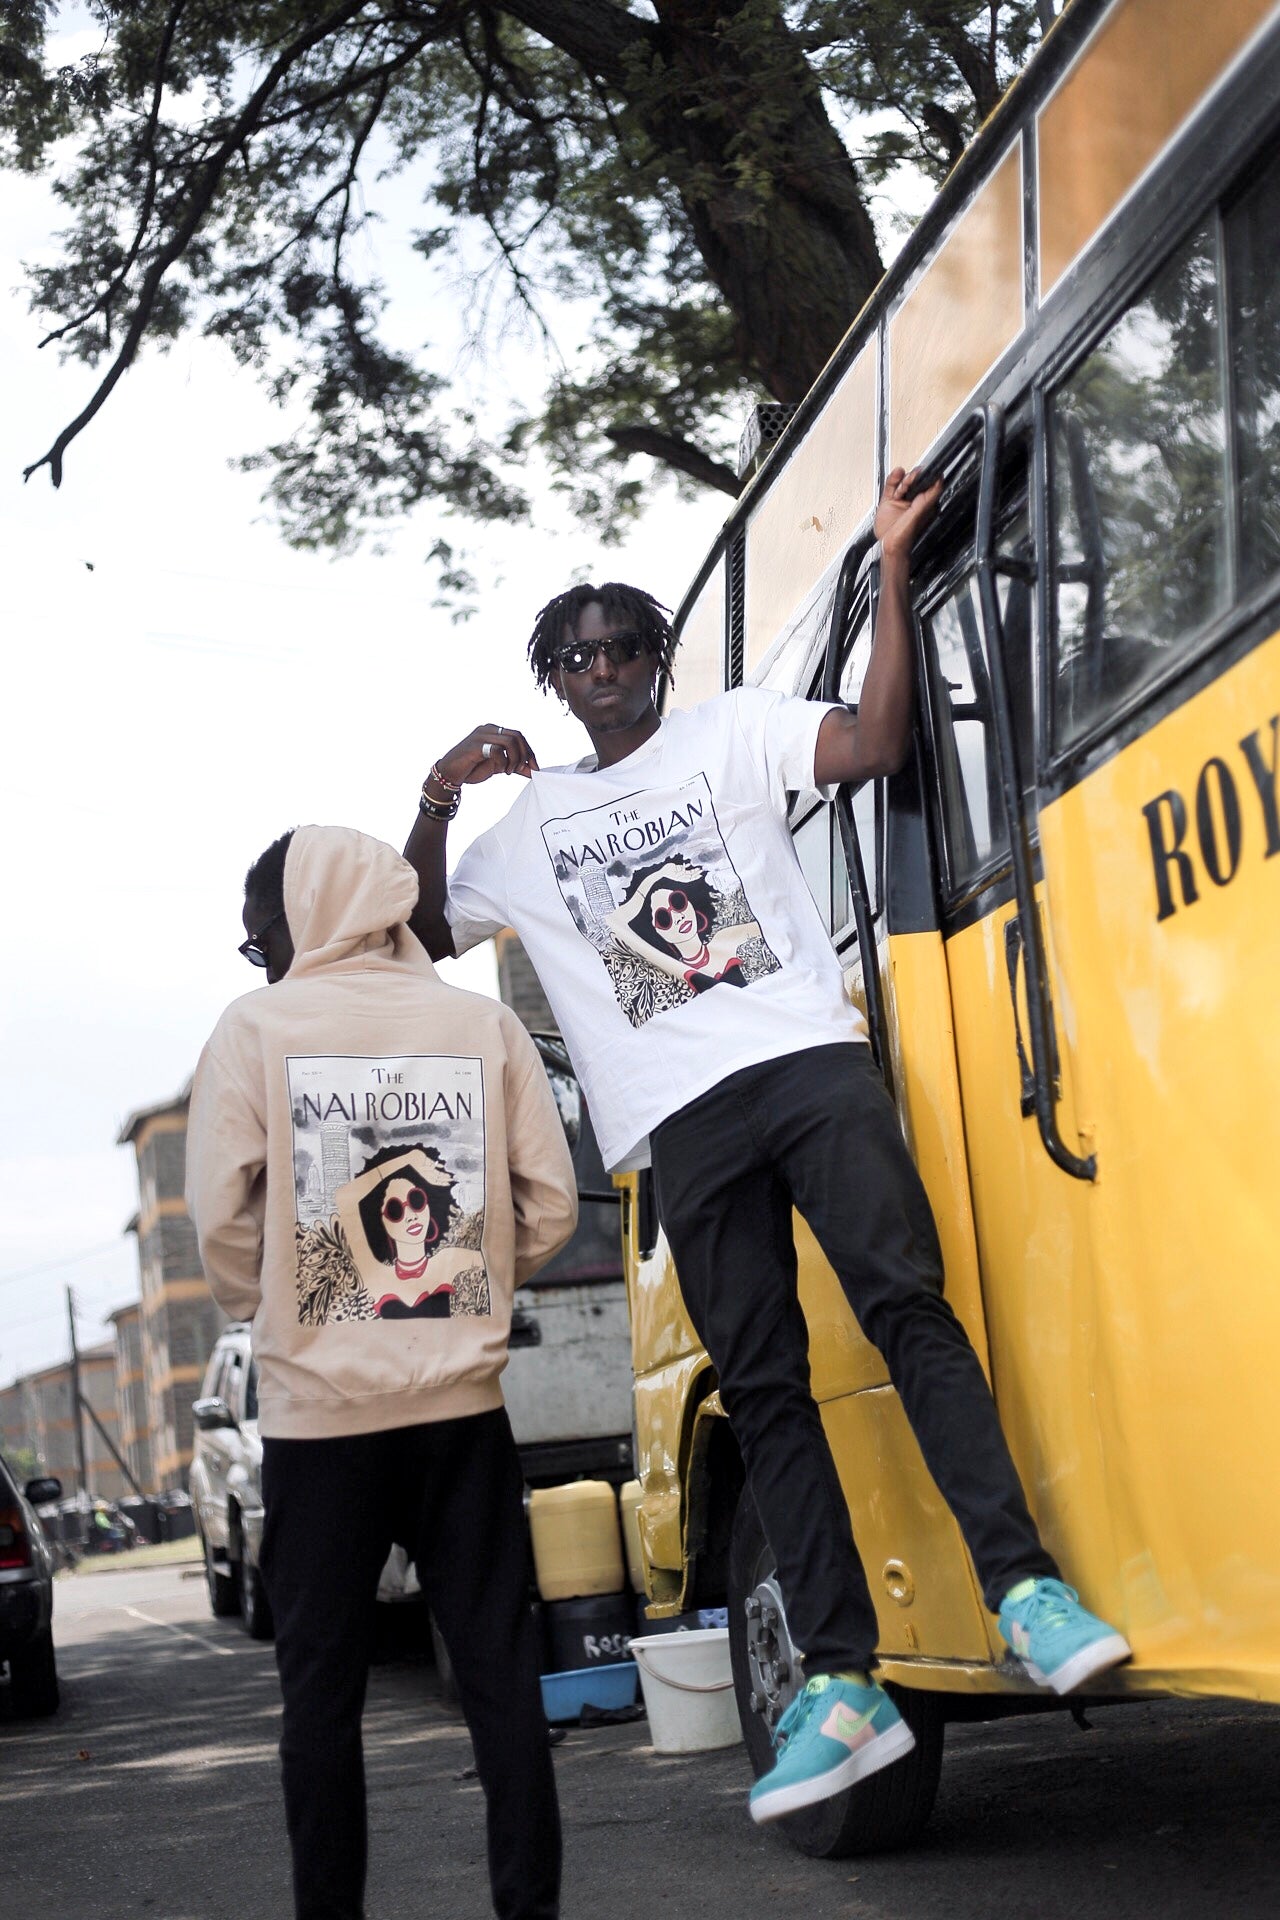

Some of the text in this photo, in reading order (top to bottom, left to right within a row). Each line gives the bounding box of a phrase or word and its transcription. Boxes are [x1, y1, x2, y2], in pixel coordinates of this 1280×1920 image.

[609, 809, 641, 826] THE
[559, 798, 703, 872] NAIROBIAN
[371, 1067, 404, 1084] THE
[302, 1091, 472, 1121] NAIROBIAN
